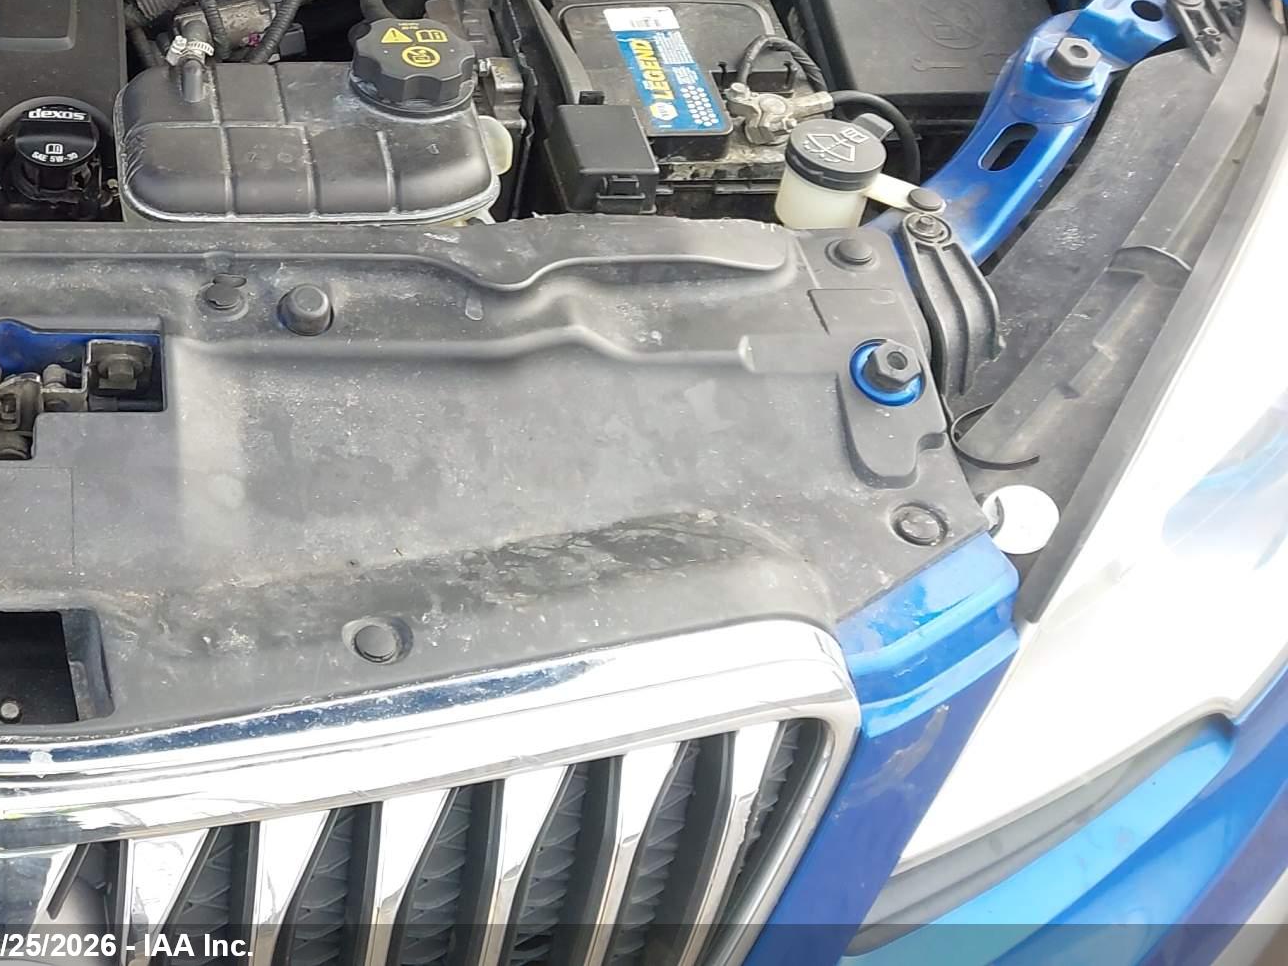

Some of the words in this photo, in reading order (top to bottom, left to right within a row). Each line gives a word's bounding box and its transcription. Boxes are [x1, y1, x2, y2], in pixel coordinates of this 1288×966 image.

[629, 38, 674, 100] LEGEND
[28, 108, 87, 121] dexos
[31, 151, 49, 162] SAE
[50, 152, 79, 163] 5W-30
